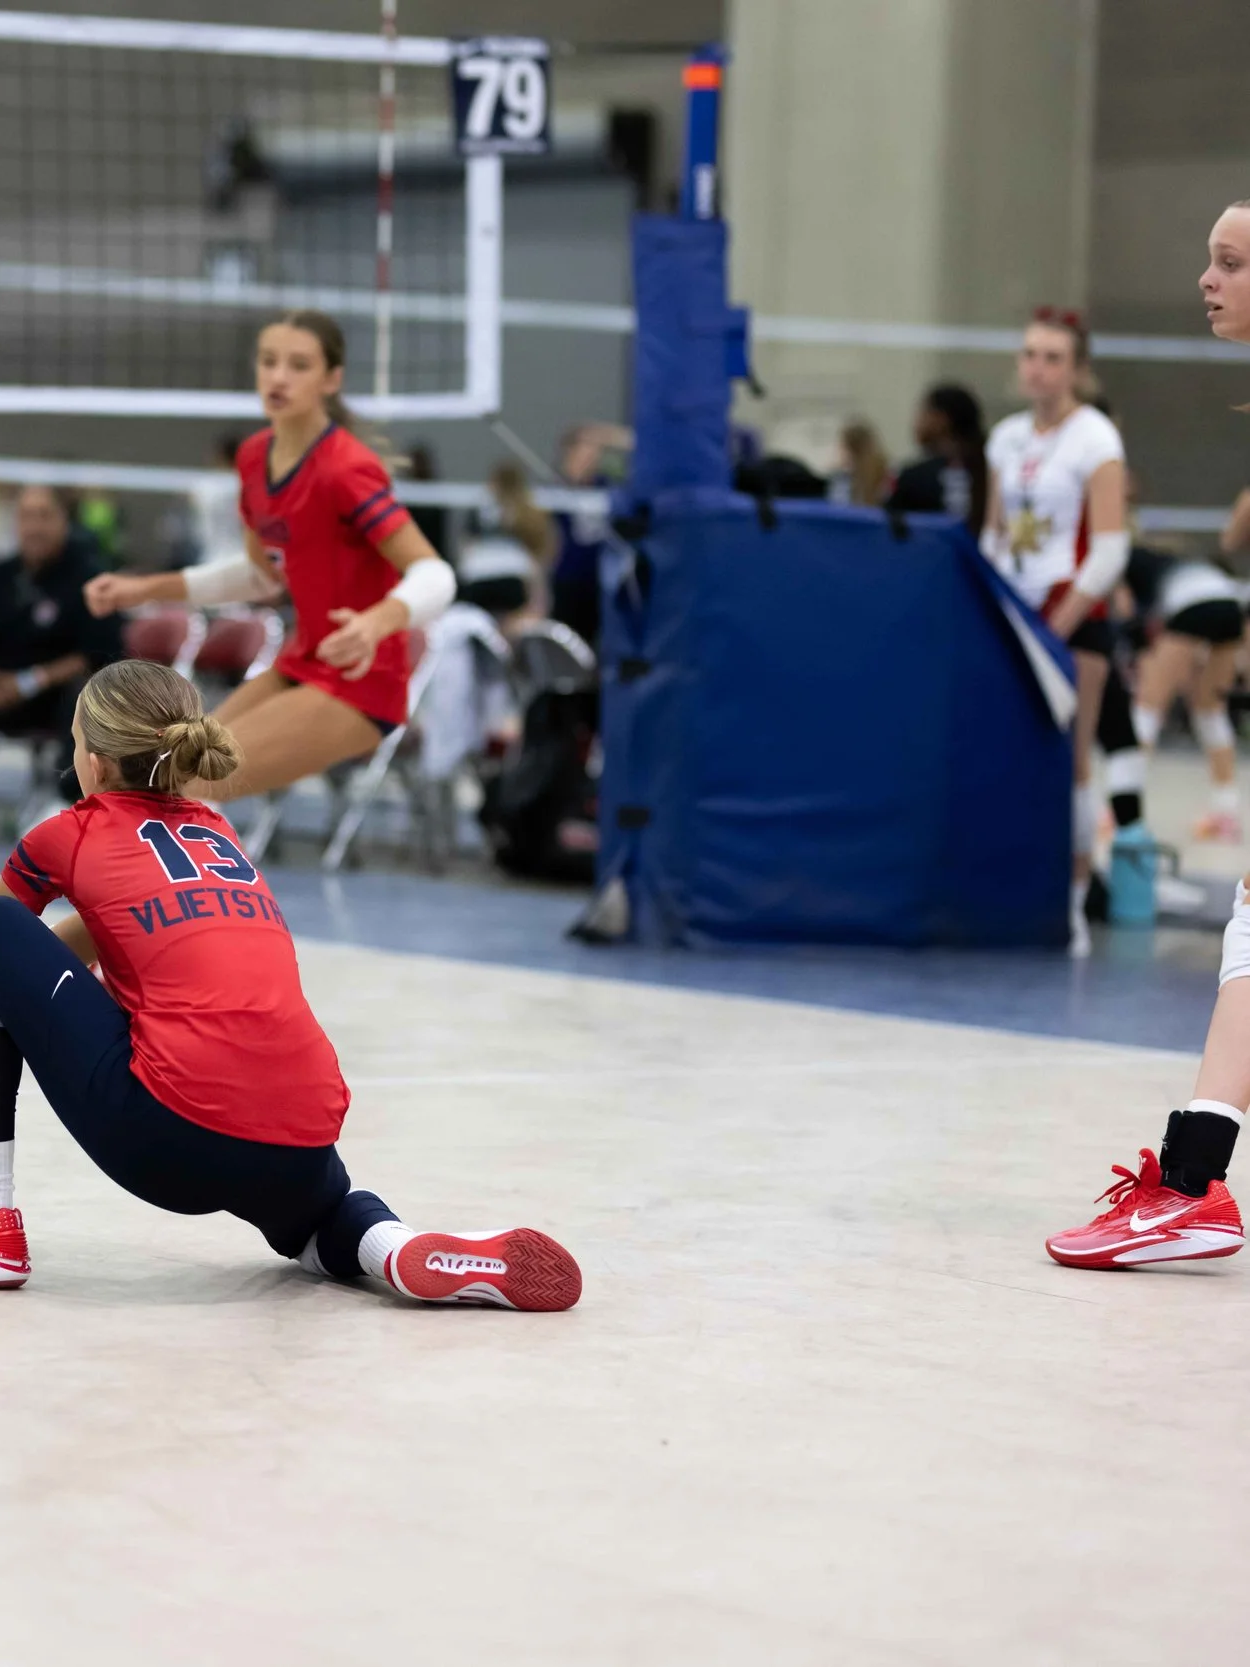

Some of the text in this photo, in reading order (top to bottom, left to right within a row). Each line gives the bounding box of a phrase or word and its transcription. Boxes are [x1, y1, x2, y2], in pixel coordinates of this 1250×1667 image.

[458, 59, 547, 138] 79
[136, 819, 259, 886] 13
[128, 887, 289, 935] VLIETSTR
